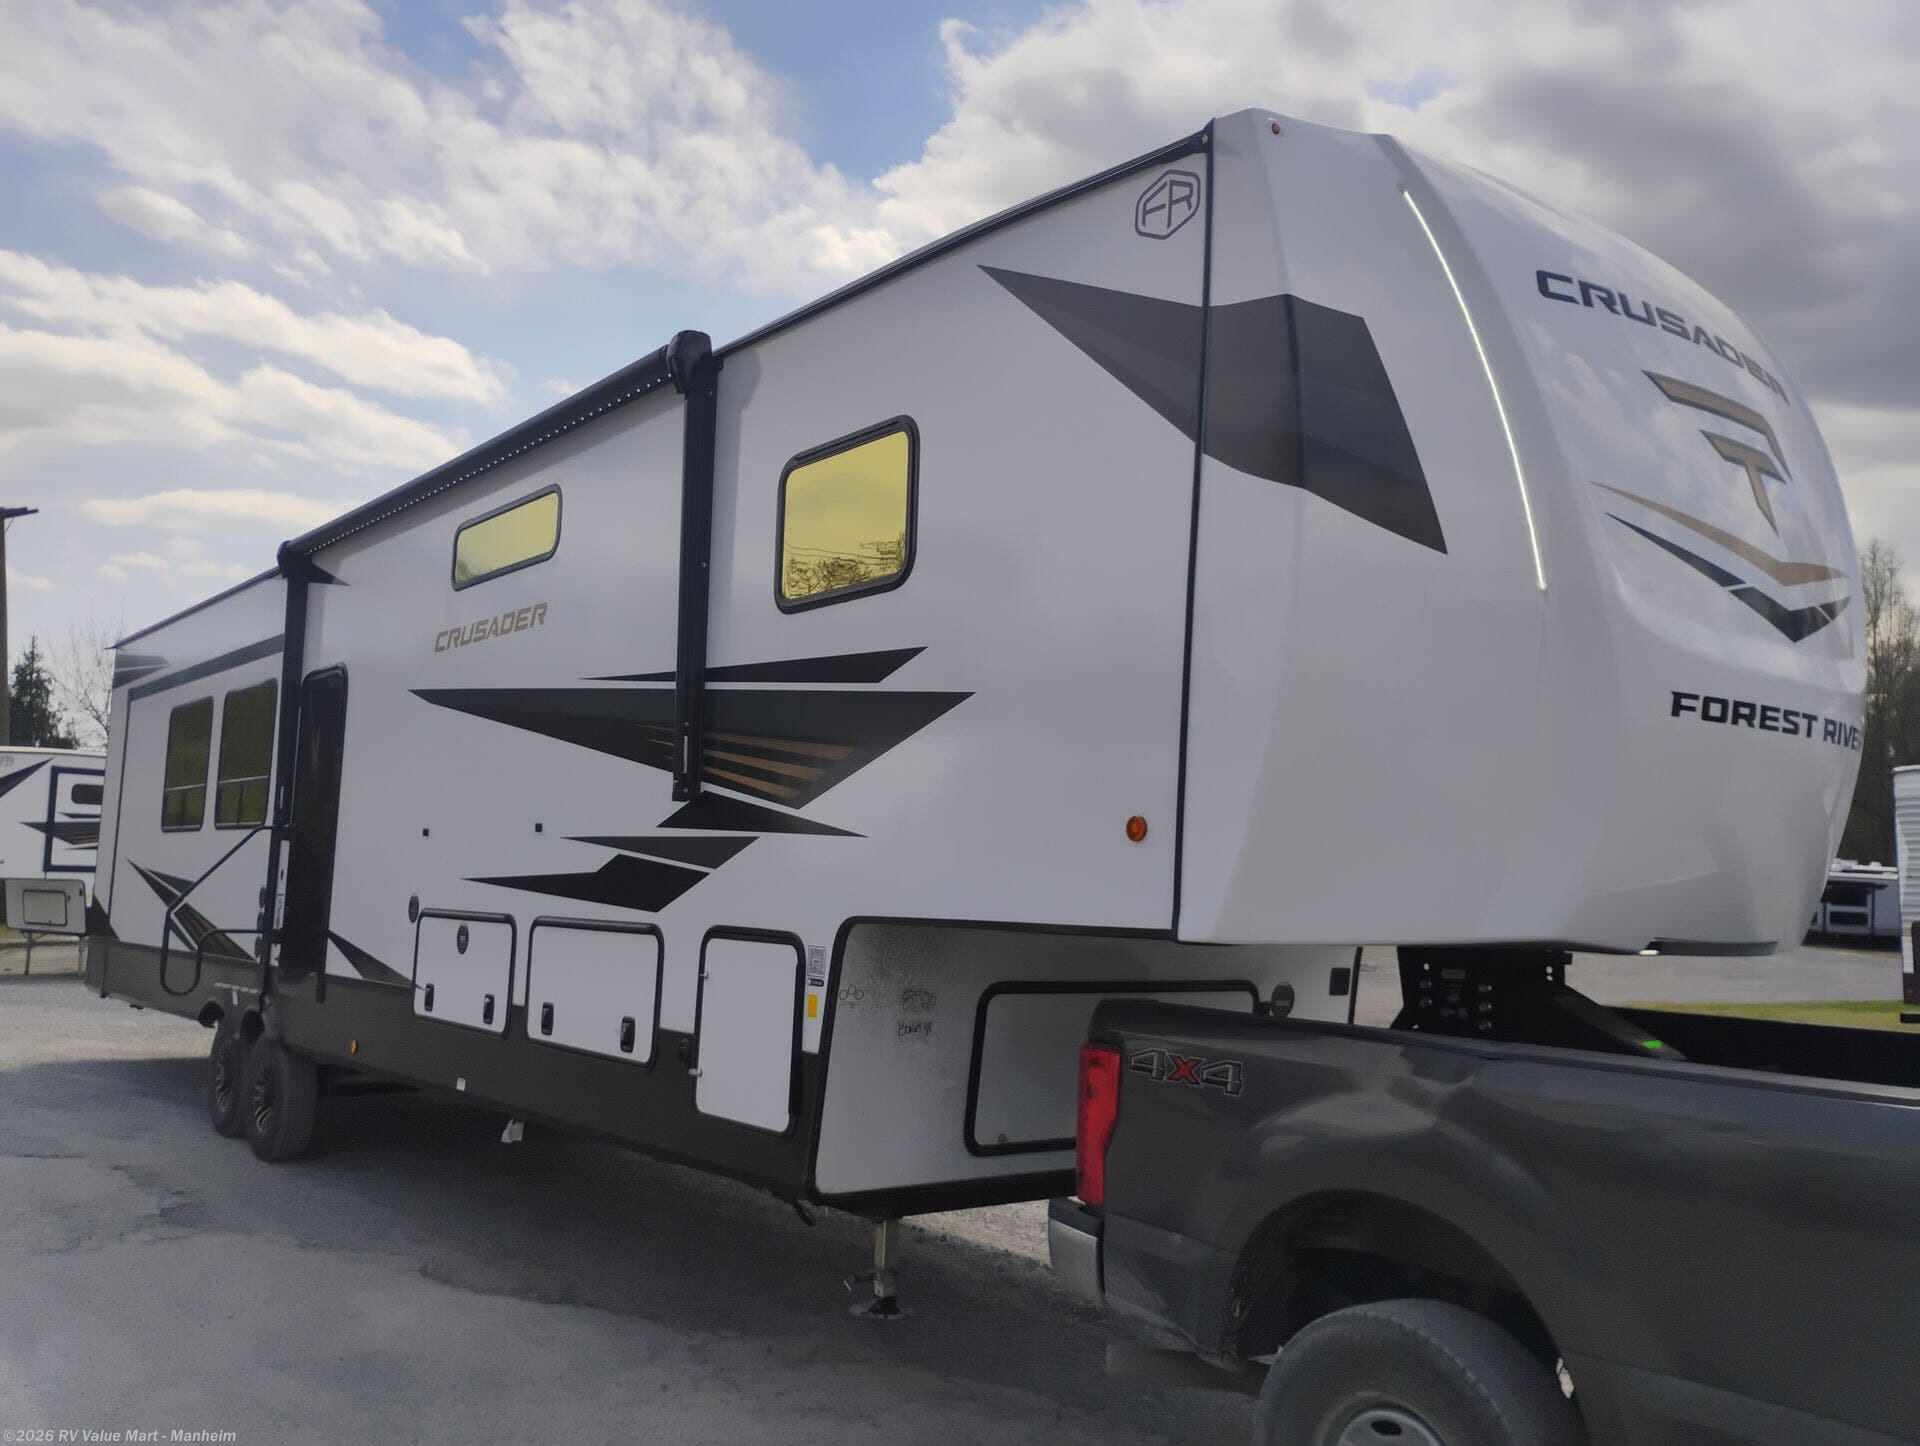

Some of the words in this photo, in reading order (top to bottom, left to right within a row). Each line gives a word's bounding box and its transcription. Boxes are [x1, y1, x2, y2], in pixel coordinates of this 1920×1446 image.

[1536, 269, 1791, 406] CRUSADER
[434, 602, 548, 653] CRUSADER
[1671, 691, 1818, 738] FOREST
